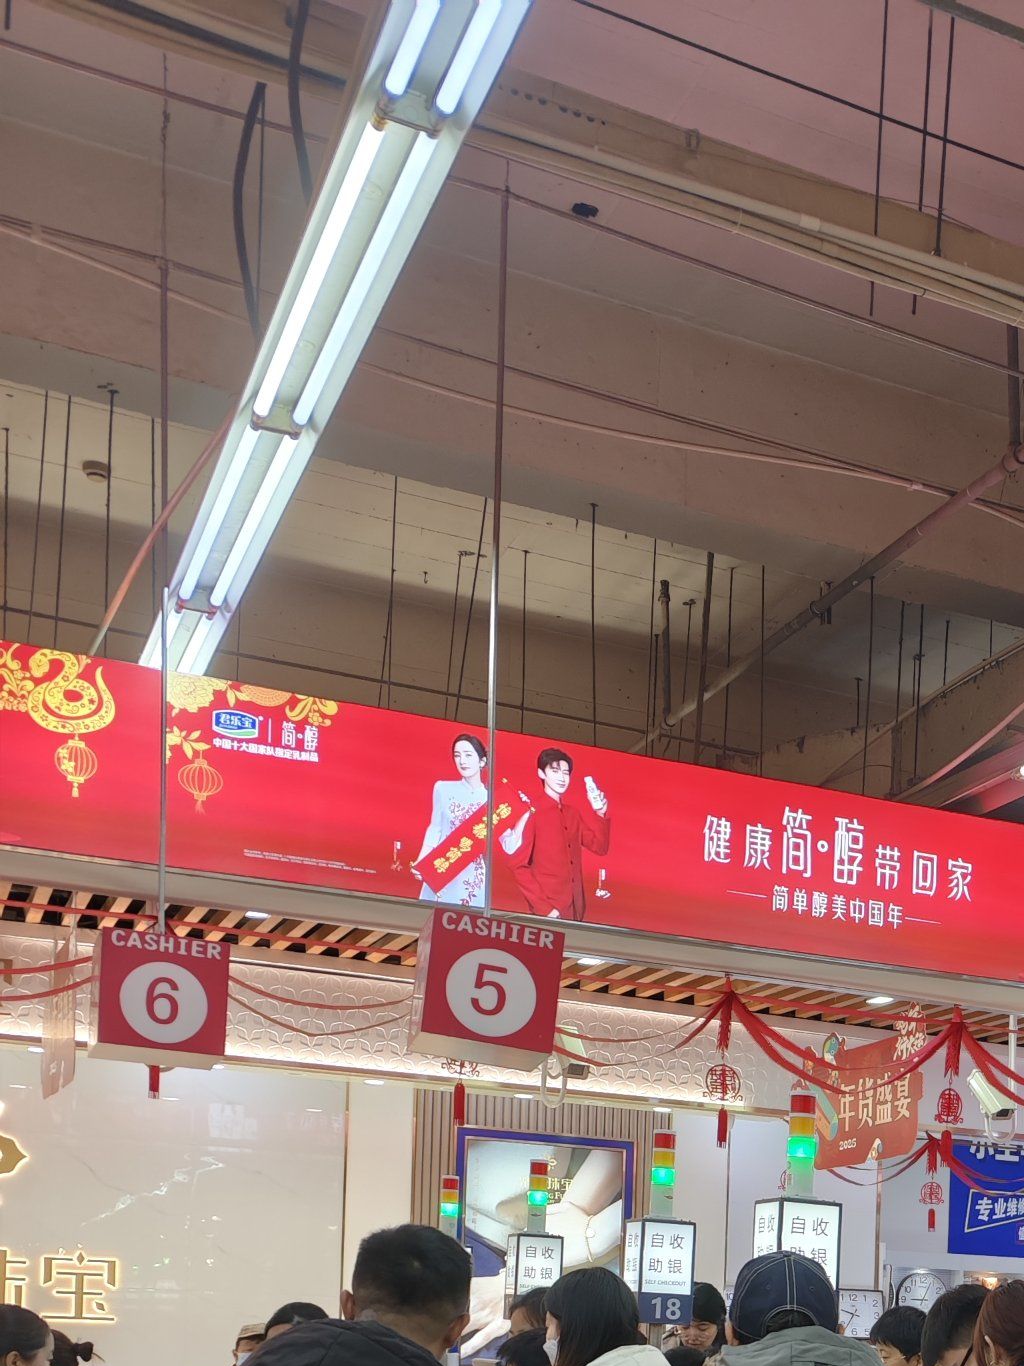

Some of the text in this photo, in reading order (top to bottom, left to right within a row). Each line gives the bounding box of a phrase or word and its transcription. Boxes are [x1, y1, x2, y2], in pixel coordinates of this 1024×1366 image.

[772, 885, 903, 929] 简单醇美中国年
[111, 929, 222, 960] CASHIER
[441, 911, 555, 950] CASHIER
[146, 977, 179, 1025] 6
[470, 963, 508, 1016] 5
[839, 1070, 912, 1131] 年货盛宴
[839, 1139, 857, 1150] 2025
[651, 1297, 681, 1320] 18
